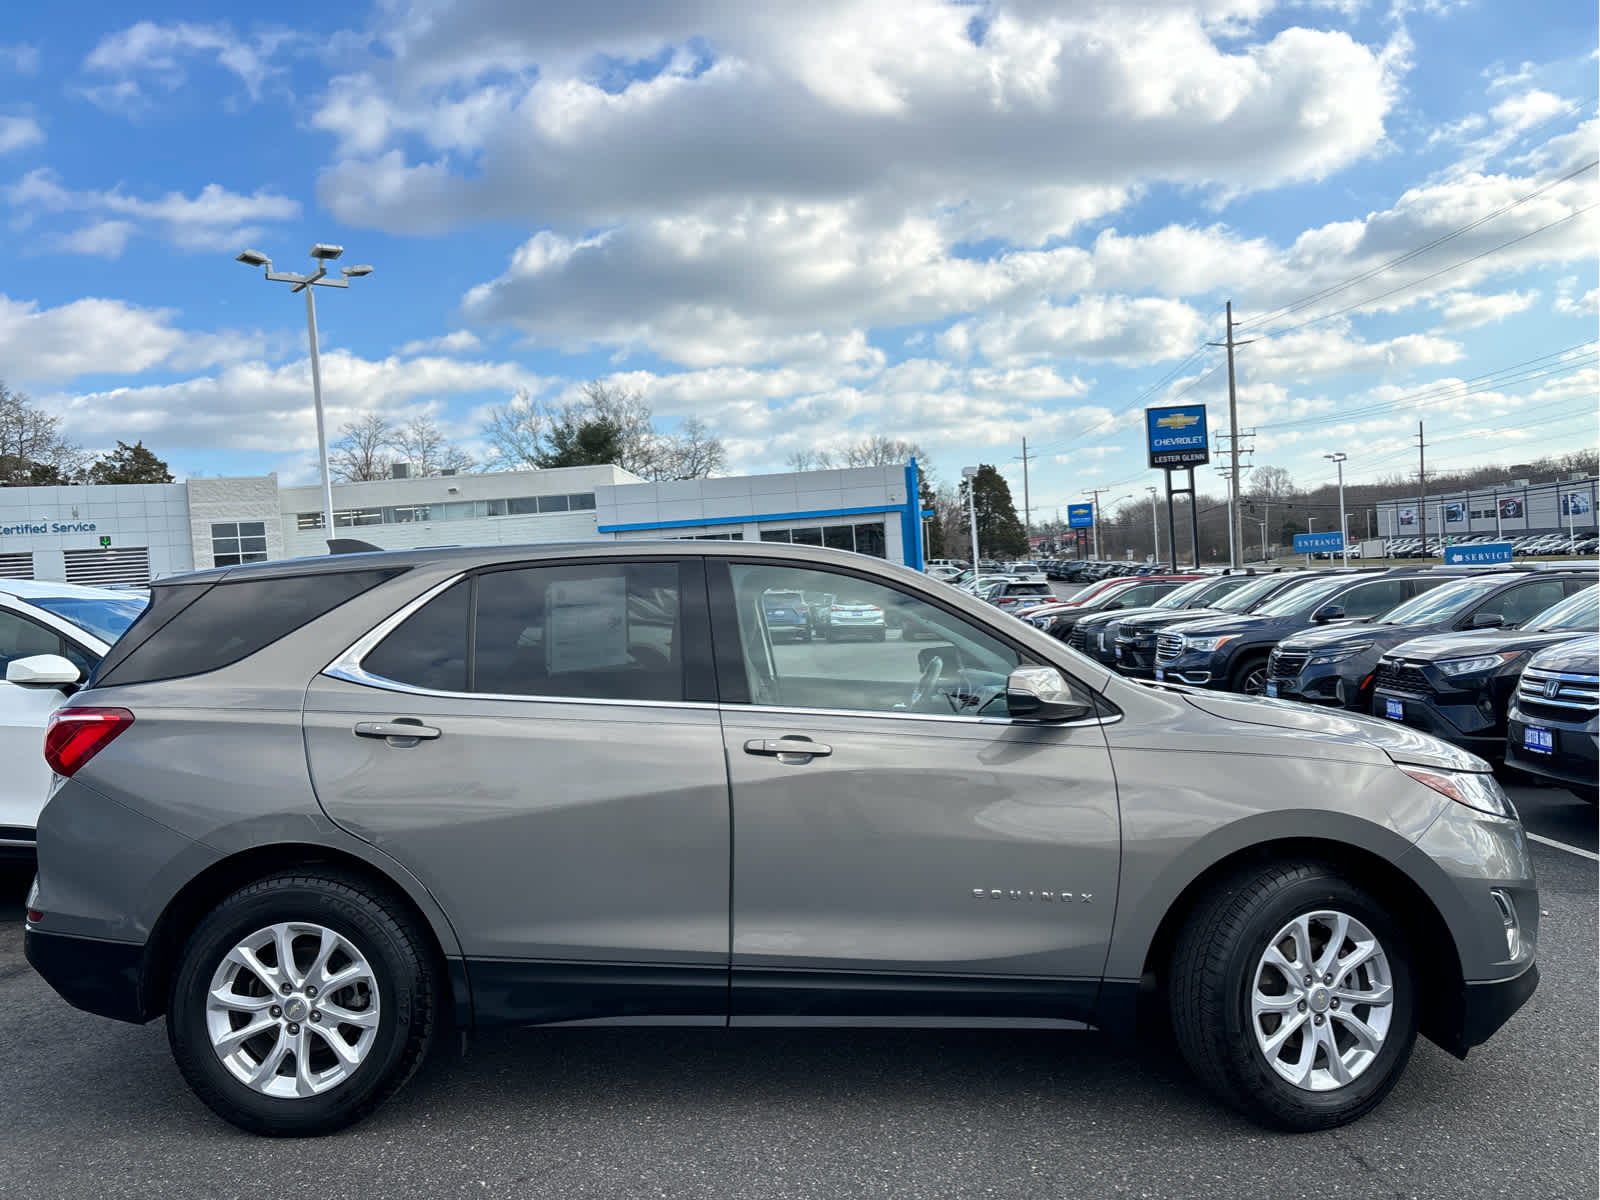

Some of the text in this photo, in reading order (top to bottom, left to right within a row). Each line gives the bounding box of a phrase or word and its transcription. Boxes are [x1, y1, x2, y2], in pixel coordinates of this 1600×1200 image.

[1154, 436, 1202, 446] CHEVROLET
[1154, 453, 1206, 464] LESTER GLENN
[51, 521, 97, 533] Service
[1298, 537, 1341, 547] ENTRANCE
[1464, 551, 1509, 561] SERVICE
[972, 887, 1094, 904] EQUINOX
